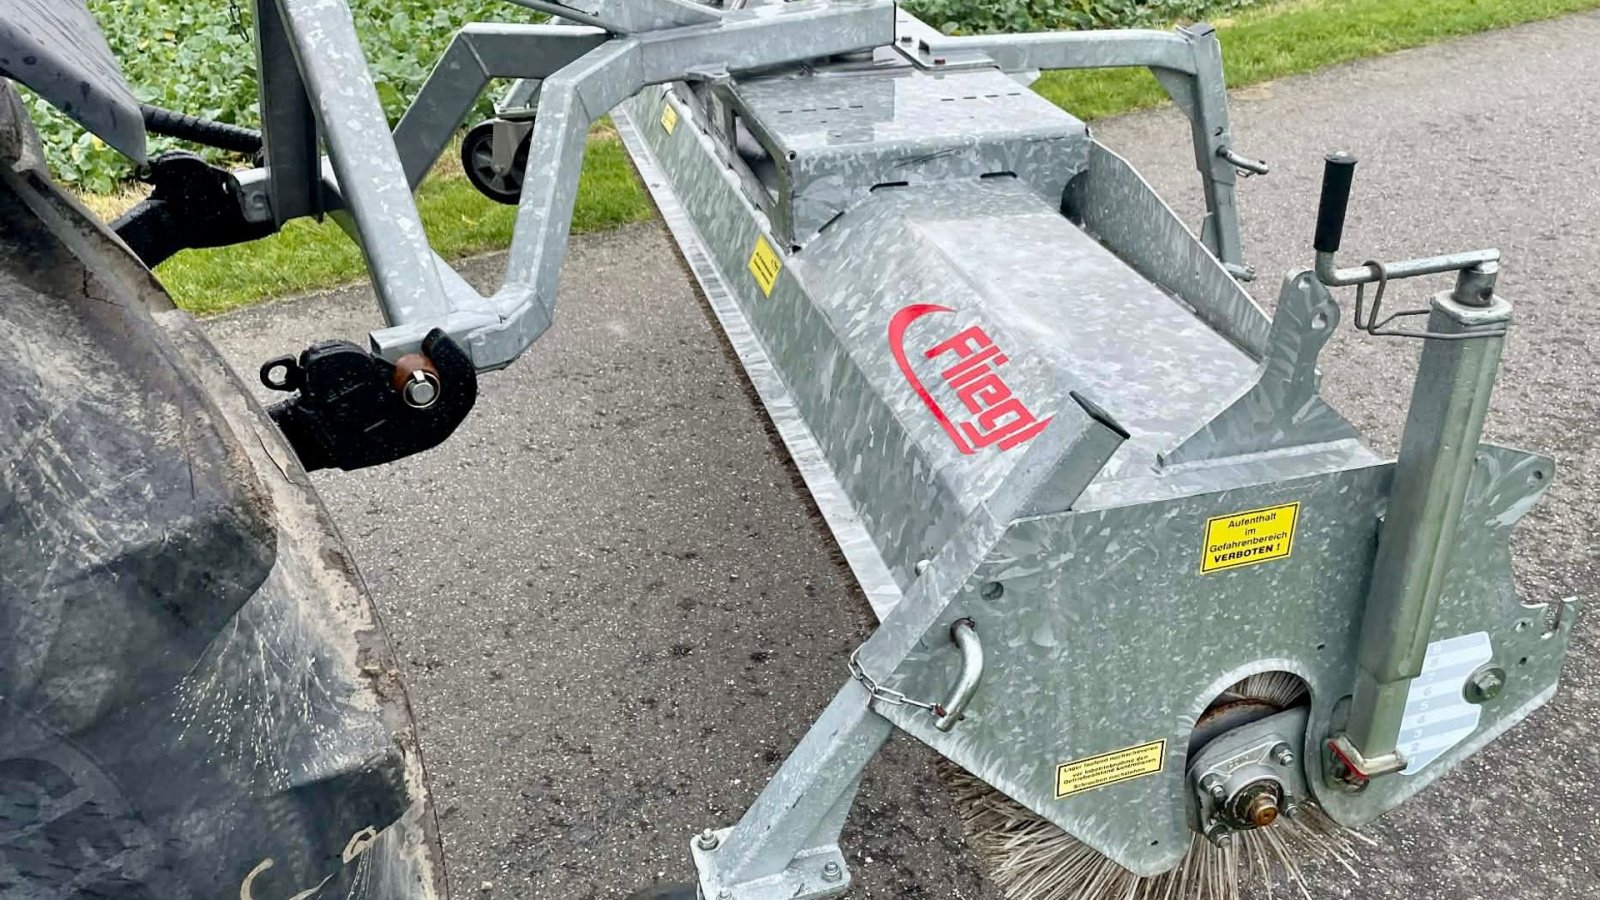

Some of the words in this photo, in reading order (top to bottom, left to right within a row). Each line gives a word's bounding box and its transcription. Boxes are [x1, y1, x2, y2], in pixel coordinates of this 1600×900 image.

[924, 325, 1055, 451] Fliegl
[1228, 512, 1277, 528] Aufenthalt
[1245, 528, 1256, 536] im
[1209, 531, 1287, 553] Gefahrenbereich
[1214, 544, 1274, 563] VERBOTEN
[1423, 686, 1432, 696] 6
[1420, 701, 1429, 711] 5
[1411, 742, 1420, 752] 2
